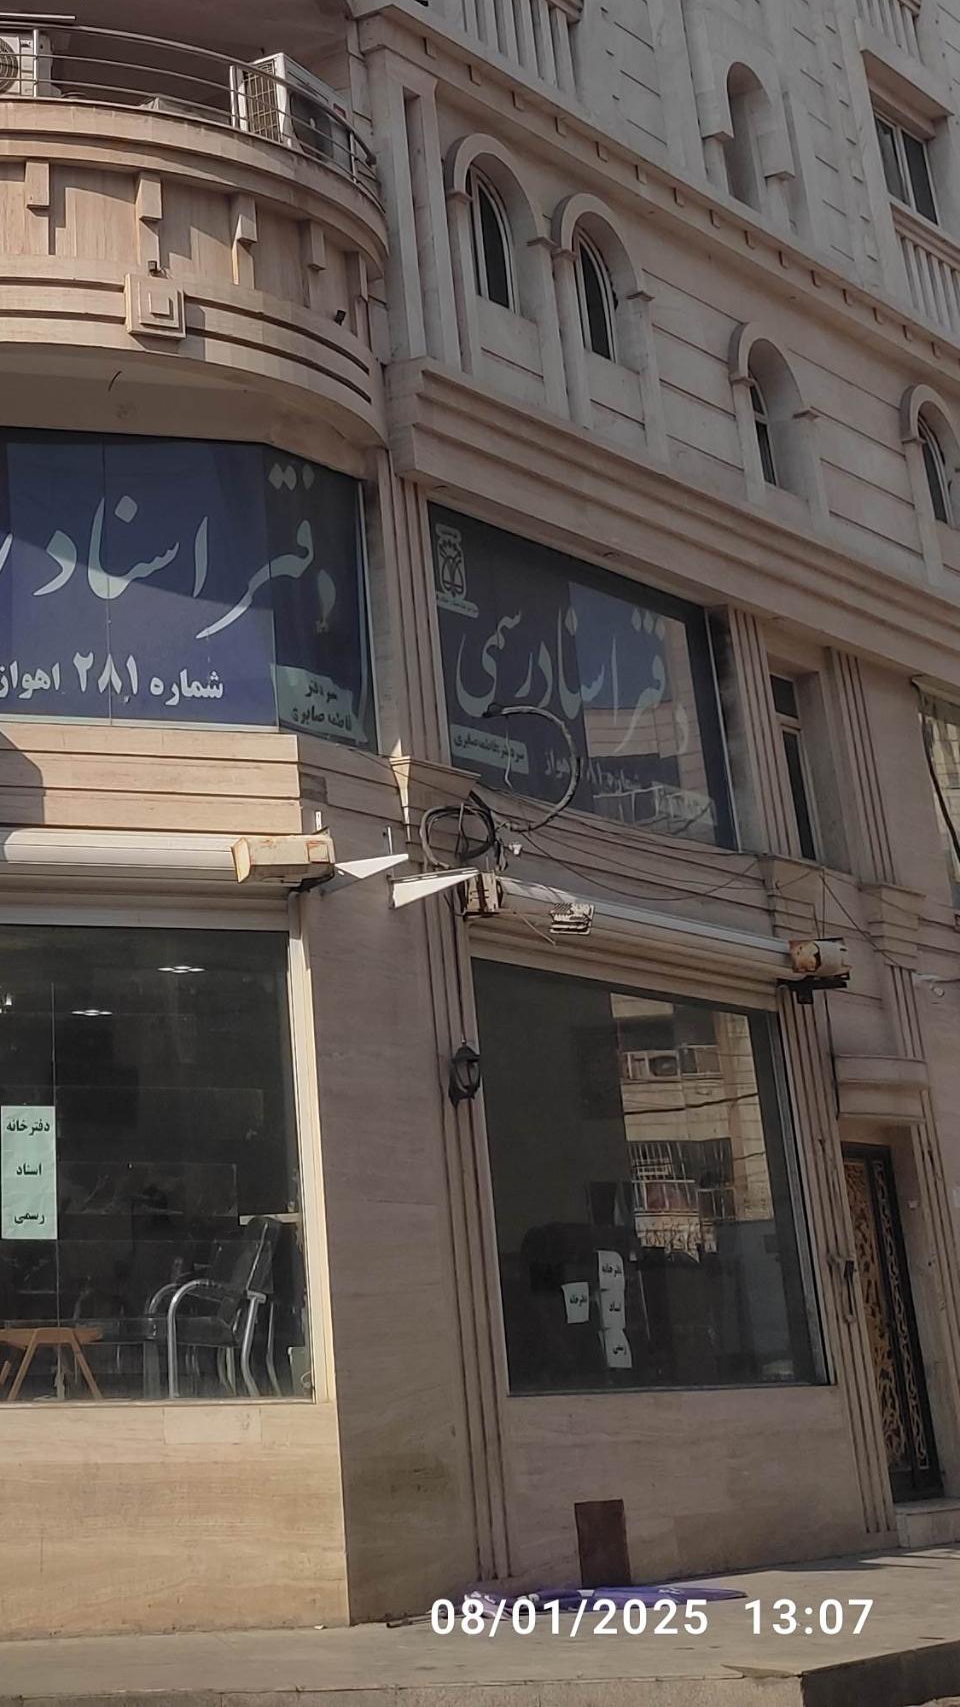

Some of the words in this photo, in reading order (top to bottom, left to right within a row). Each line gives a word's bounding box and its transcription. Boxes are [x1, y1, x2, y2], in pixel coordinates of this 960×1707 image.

[33, 493, 209, 600] اسناد
[196, 462, 337, 640] دفتر
[73, 652, 139, 695] ۲۸۱
[149, 669, 224, 706] شماره
[16, 1162, 42, 1177] اسناد
[13, 1211, 46, 1225] رسمی
